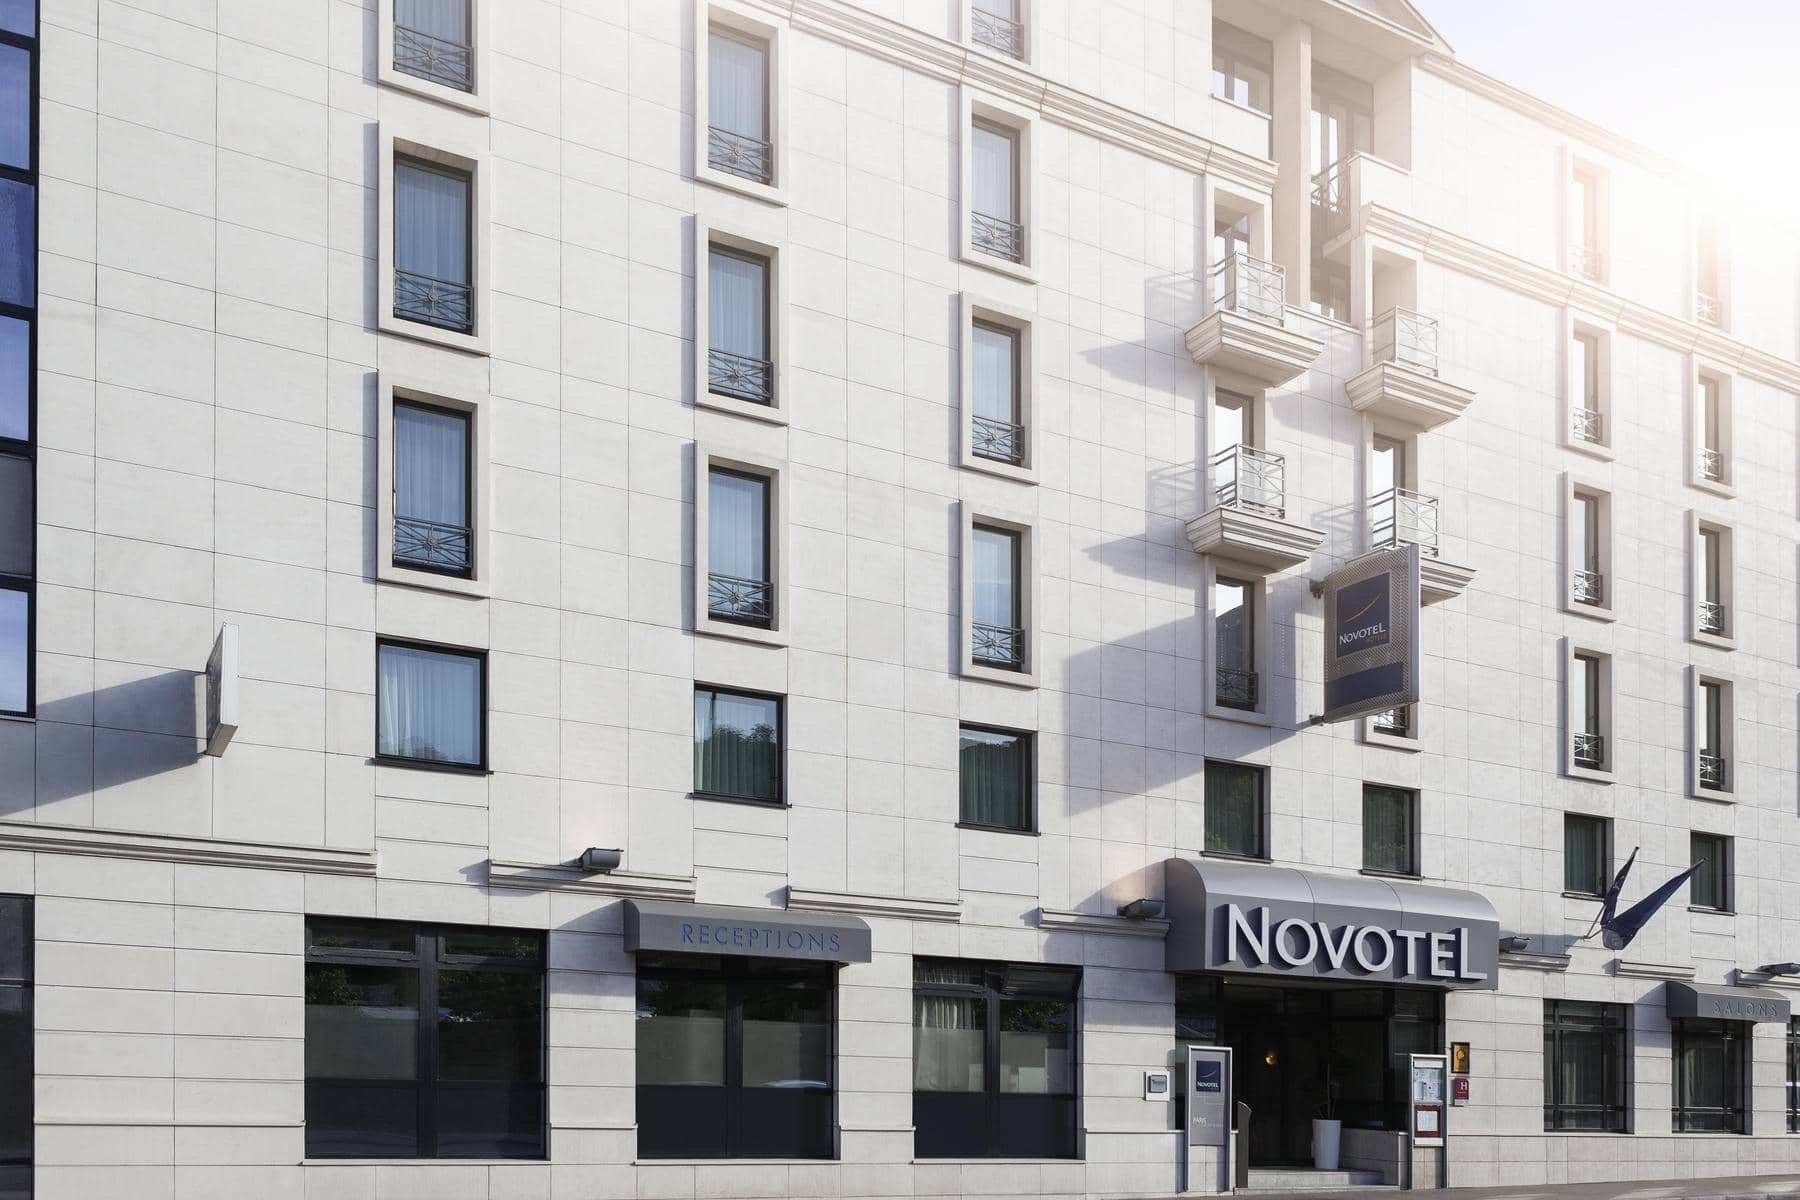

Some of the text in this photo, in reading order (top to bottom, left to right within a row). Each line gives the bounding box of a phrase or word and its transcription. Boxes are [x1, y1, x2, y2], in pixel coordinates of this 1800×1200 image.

[1339, 623, 1386, 645] NOVOTEL
[682, 924, 840, 952] RECEPTIONS
[1228, 903, 1488, 980] NOVOTEL
[1712, 1000, 1777, 1016] SALONS
[1460, 1081, 1468, 1091] H
